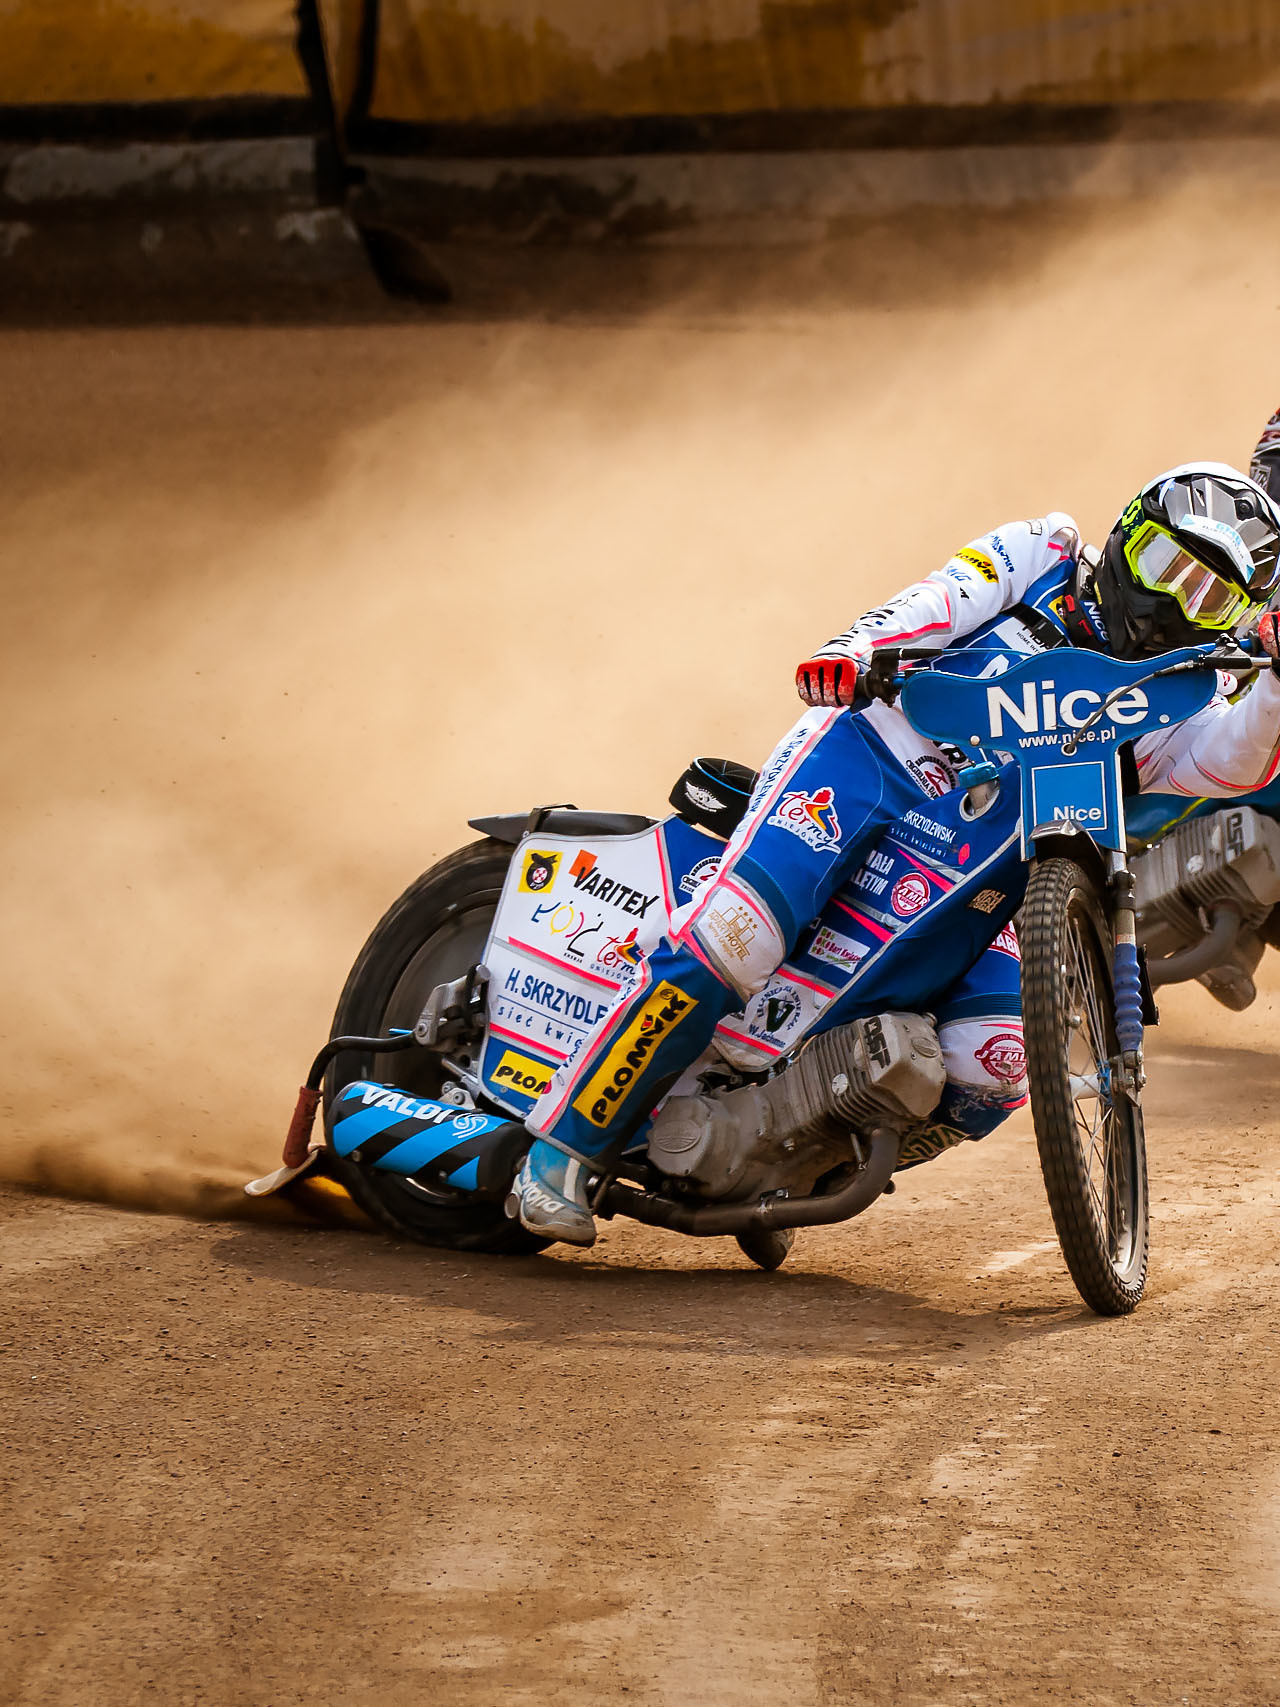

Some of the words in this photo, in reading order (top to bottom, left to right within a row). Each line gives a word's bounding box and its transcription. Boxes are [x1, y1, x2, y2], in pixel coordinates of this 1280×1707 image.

[987, 679, 1149, 738] Nice
[1053, 805, 1102, 821] Nice
[573, 866, 660, 920] VARITEX
[497, 1004, 532, 1028] sieć
[361, 1086, 455, 1124] VALDI
